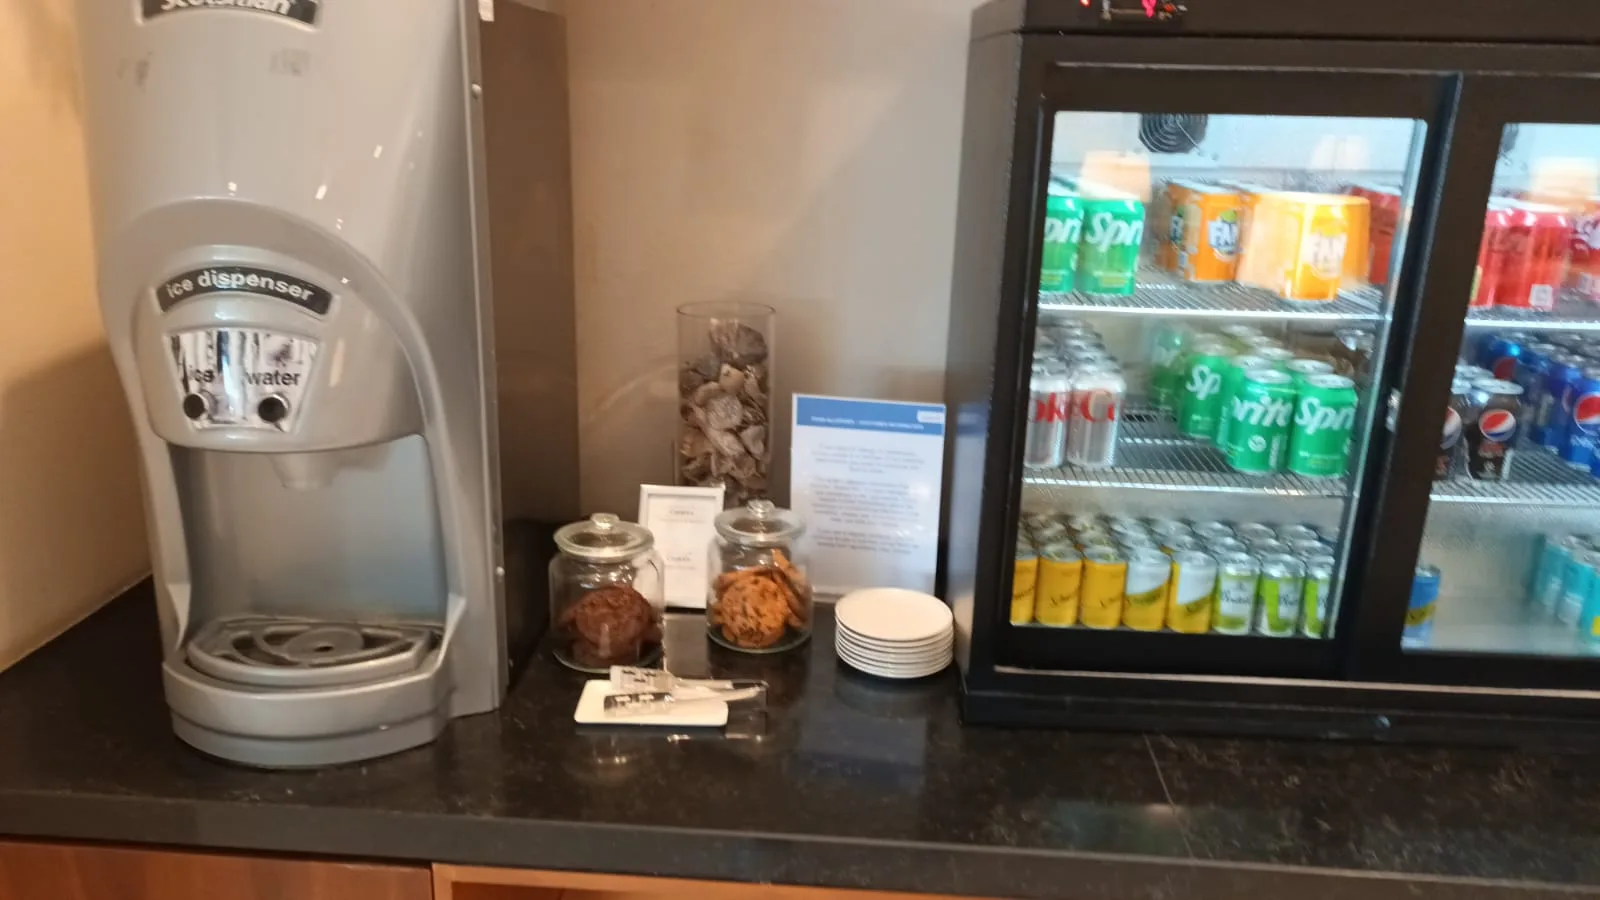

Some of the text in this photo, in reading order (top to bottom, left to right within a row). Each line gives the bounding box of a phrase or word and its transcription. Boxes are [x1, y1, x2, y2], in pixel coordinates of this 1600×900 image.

[166, 269, 315, 301] ice dispenser
[247, 369, 301, 386] water
